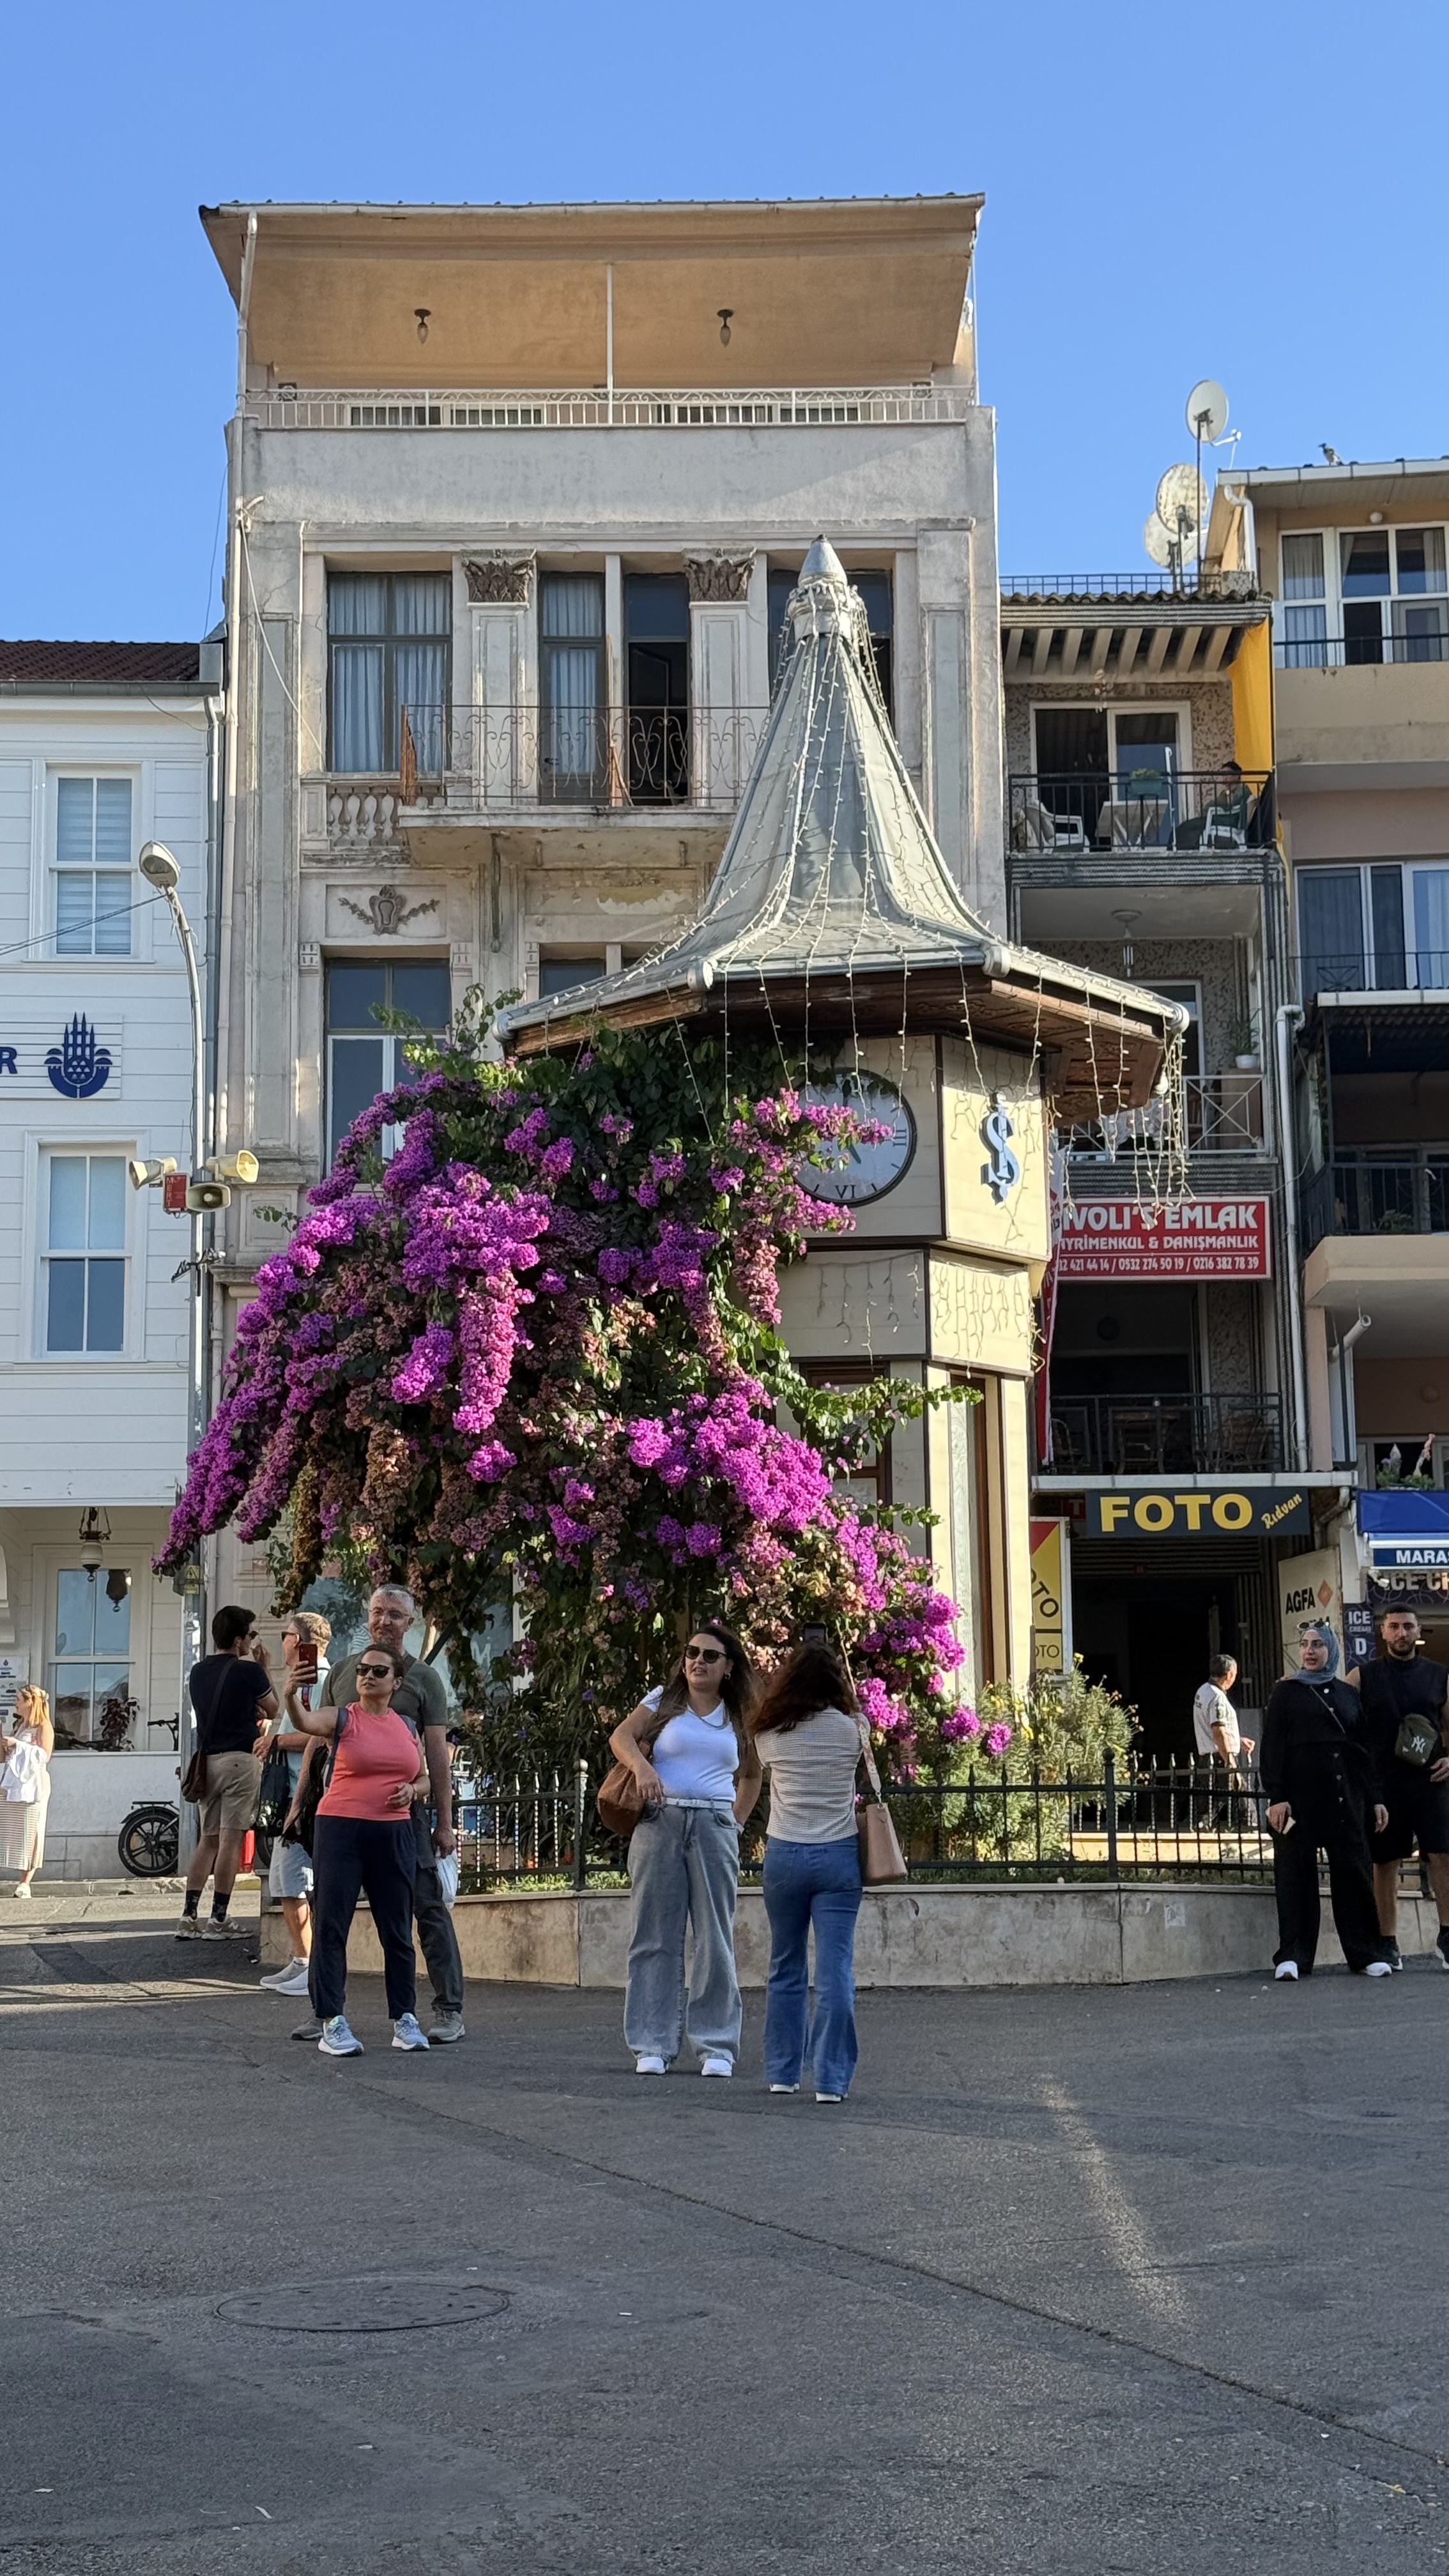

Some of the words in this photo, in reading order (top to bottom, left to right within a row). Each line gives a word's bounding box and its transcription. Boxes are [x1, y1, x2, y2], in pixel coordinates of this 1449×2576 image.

[835, 1184, 857, 1199] VI
[1165, 1205, 1258, 1232] EMLAK
[1148, 1236, 1159, 1249] &
[1163, 1236, 1259, 1251] DANIŞMANLIK
[1070, 1258, 1084, 1271] 421
[1087, 1258, 1098, 1271] 44
[1100, 1258, 1109, 1271] 14
[1119, 1257, 1140, 1271] 0532
[1142, 1257, 1158, 1271] 274
[1160, 1257, 1172, 1271] 50
[1174, 1257, 1184, 1270] 19
[1193, 1257, 1215, 1270] 0216
[1216, 1257, 1232, 1270] 382
[1234, 1257, 1245, 1270] 78
[1247, 1256, 1259, 1269] 39
[1100, 1493, 1253, 1532] FOTO
[1395, 1550, 1449, 1564] MARA
[1384, 1570, 1419, 1591] CE
[1285, 1587, 1315, 1615] AGFA
[1348, 1611, 1371, 1625] ICE
[1355, 1637, 1367, 1655] D
